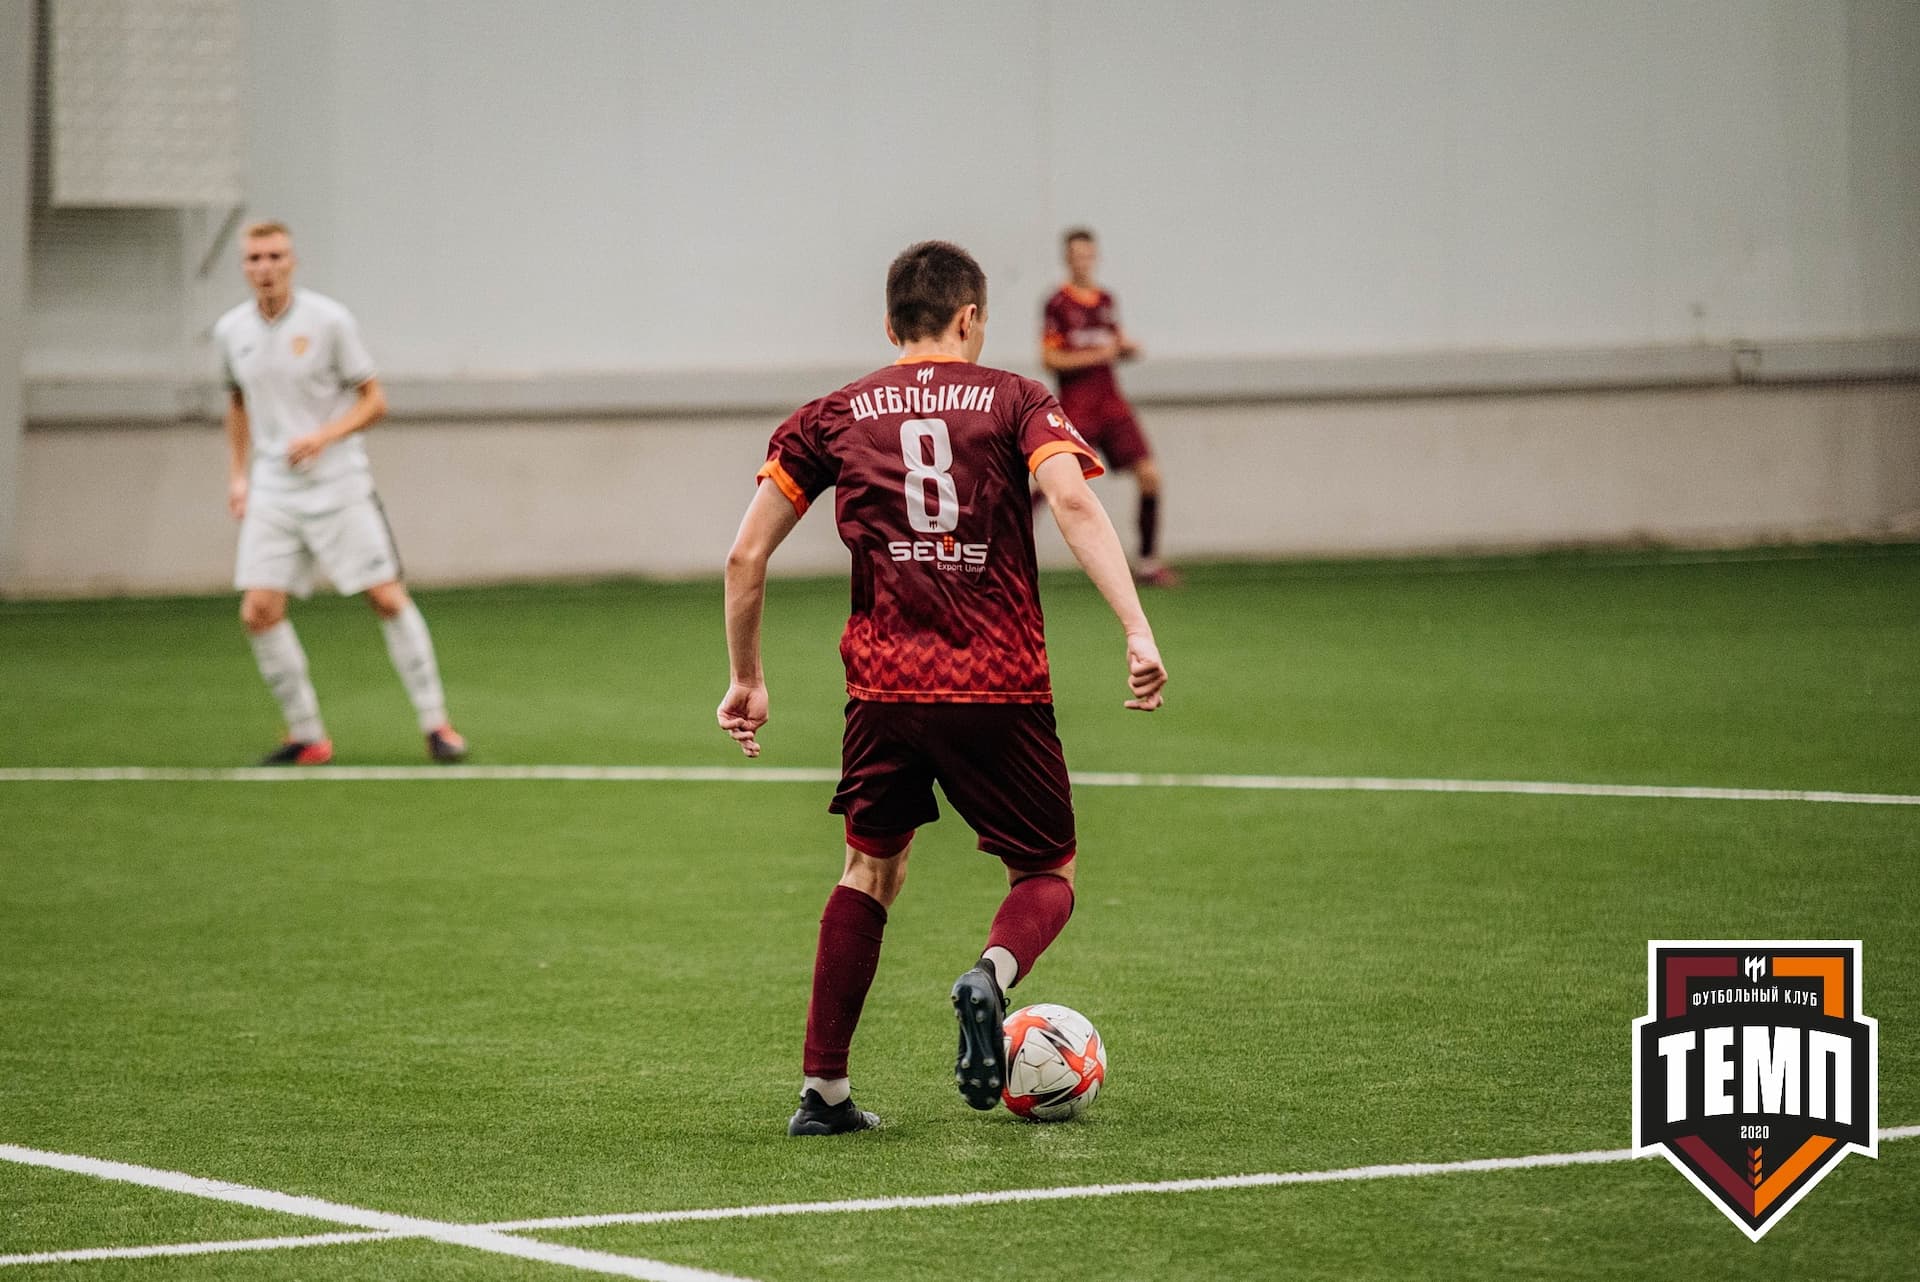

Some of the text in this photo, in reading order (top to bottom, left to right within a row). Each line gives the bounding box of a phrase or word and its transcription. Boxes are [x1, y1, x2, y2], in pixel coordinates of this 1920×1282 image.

[850, 384, 996, 421] ЩЕБЛЫКИН
[900, 418, 960, 533] 8
[888, 541, 988, 564] SEUS
[937, 562, 963, 572] Export
